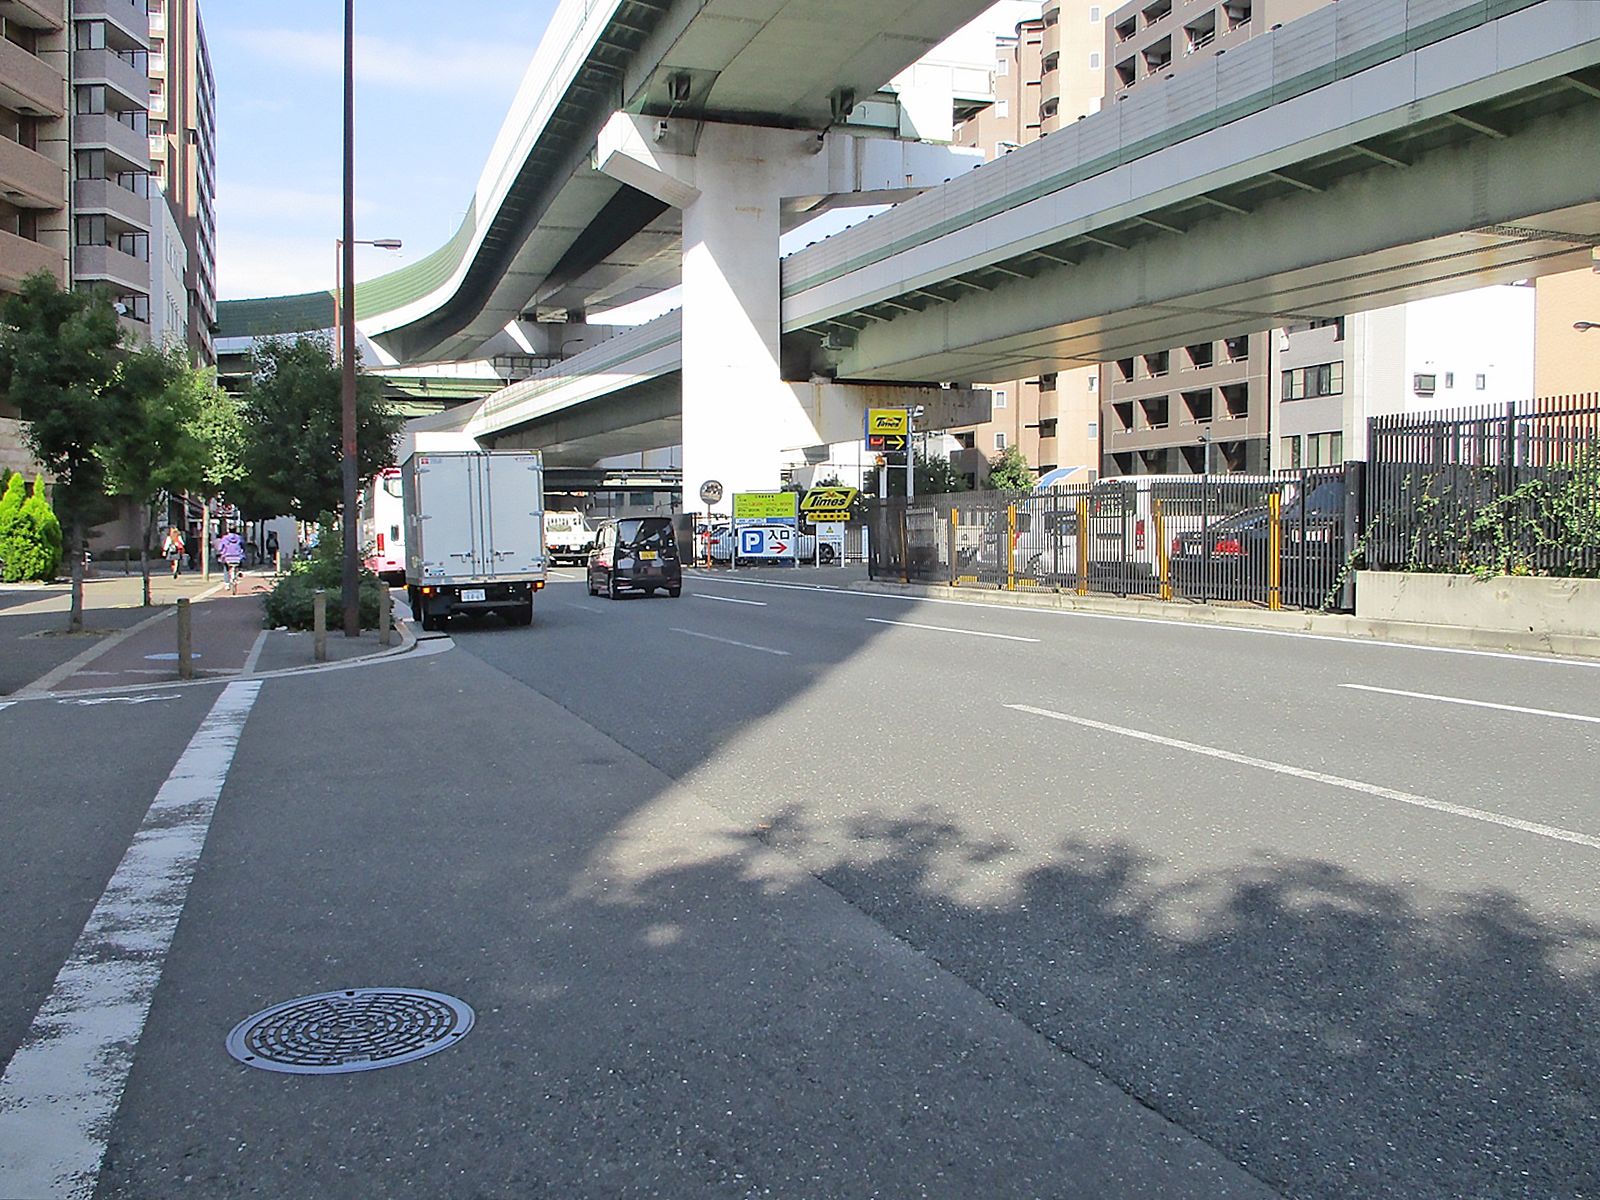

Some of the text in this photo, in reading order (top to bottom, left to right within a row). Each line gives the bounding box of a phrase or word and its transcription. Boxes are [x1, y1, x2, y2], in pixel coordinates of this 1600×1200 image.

[876, 417, 902, 428] Times
[808, 491, 848, 508] Times
[768, 529, 790, 540] 入口
[745, 533, 760, 551] P
